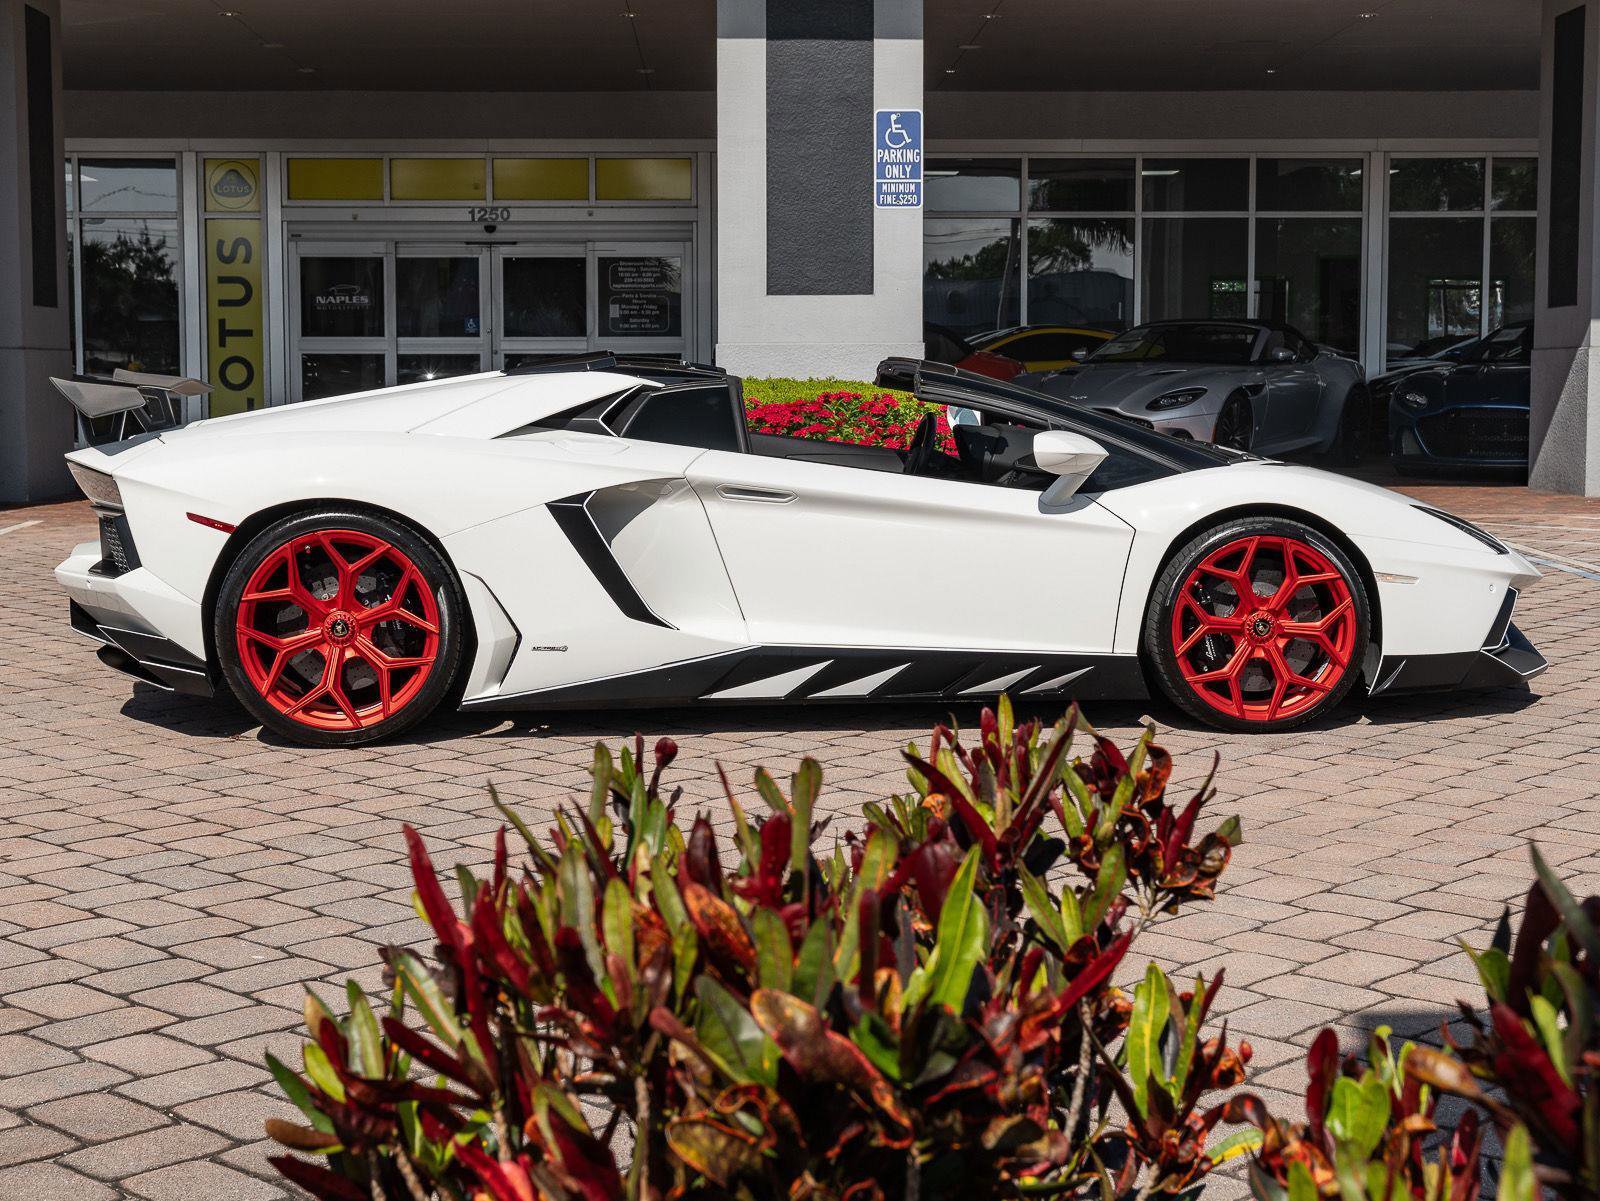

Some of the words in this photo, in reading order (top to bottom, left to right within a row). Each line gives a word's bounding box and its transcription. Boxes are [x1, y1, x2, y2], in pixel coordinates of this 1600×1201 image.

[877, 149, 920, 163] PARKING
[885, 165, 912, 178] ONLY
[217, 185, 249, 193] LOTUS
[882, 183, 915, 193] MINIMUM
[880, 195, 896, 204] FINE
[899, 194, 917, 205] $250
[468, 207, 510, 221] 1250
[315, 295, 369, 304] NAPLES
